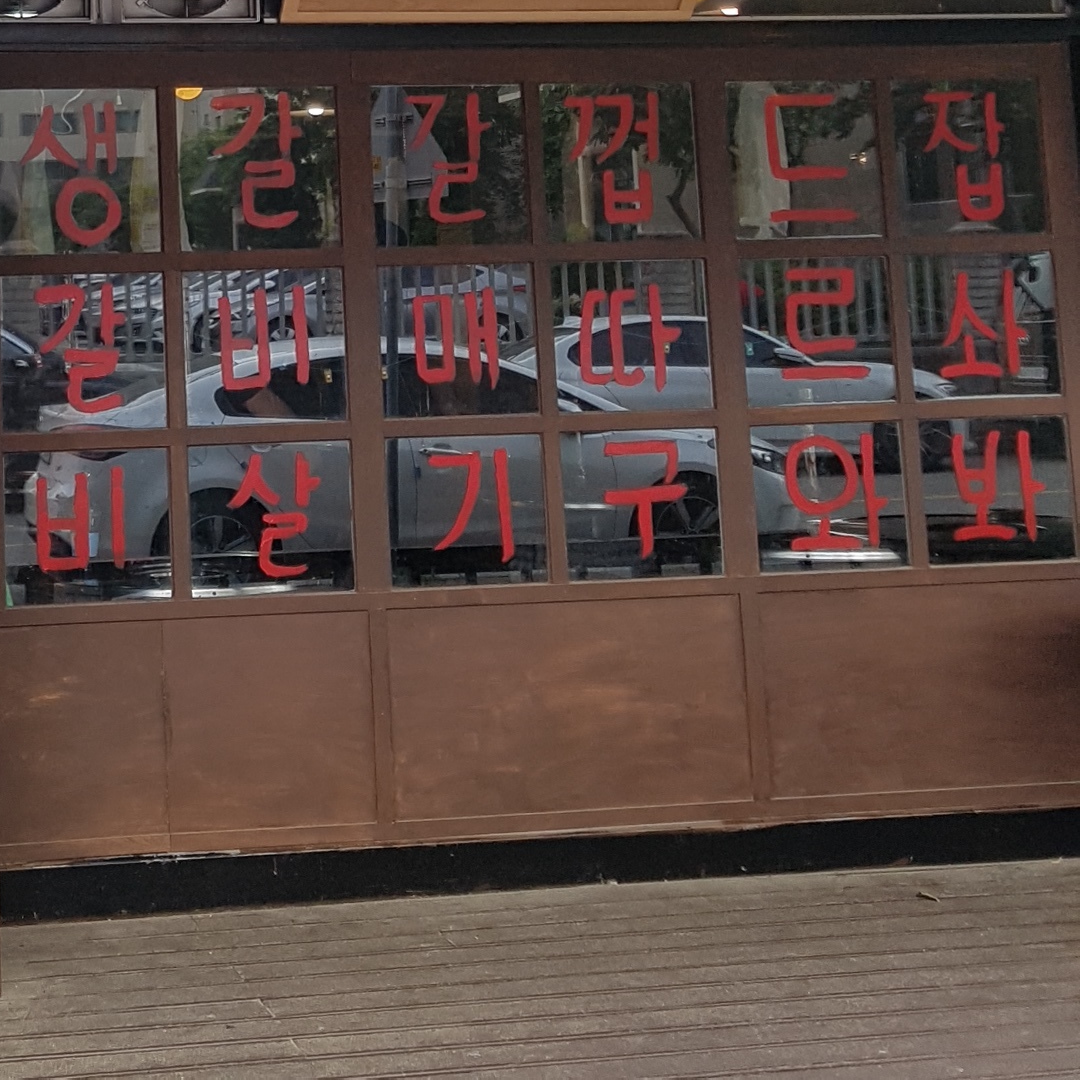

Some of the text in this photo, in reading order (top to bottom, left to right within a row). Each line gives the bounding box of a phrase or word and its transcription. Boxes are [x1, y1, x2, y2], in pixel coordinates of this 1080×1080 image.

[20, 101, 126, 572] 생갈비
[210, 91, 320, 578] 갈비살
[404, 92, 515, 564] 갈매기
[563, 91, 689, 560] 껍따구
[764, 93, 888, 551] 드르와
[922, 91, 1046, 543] 잡솨봐
